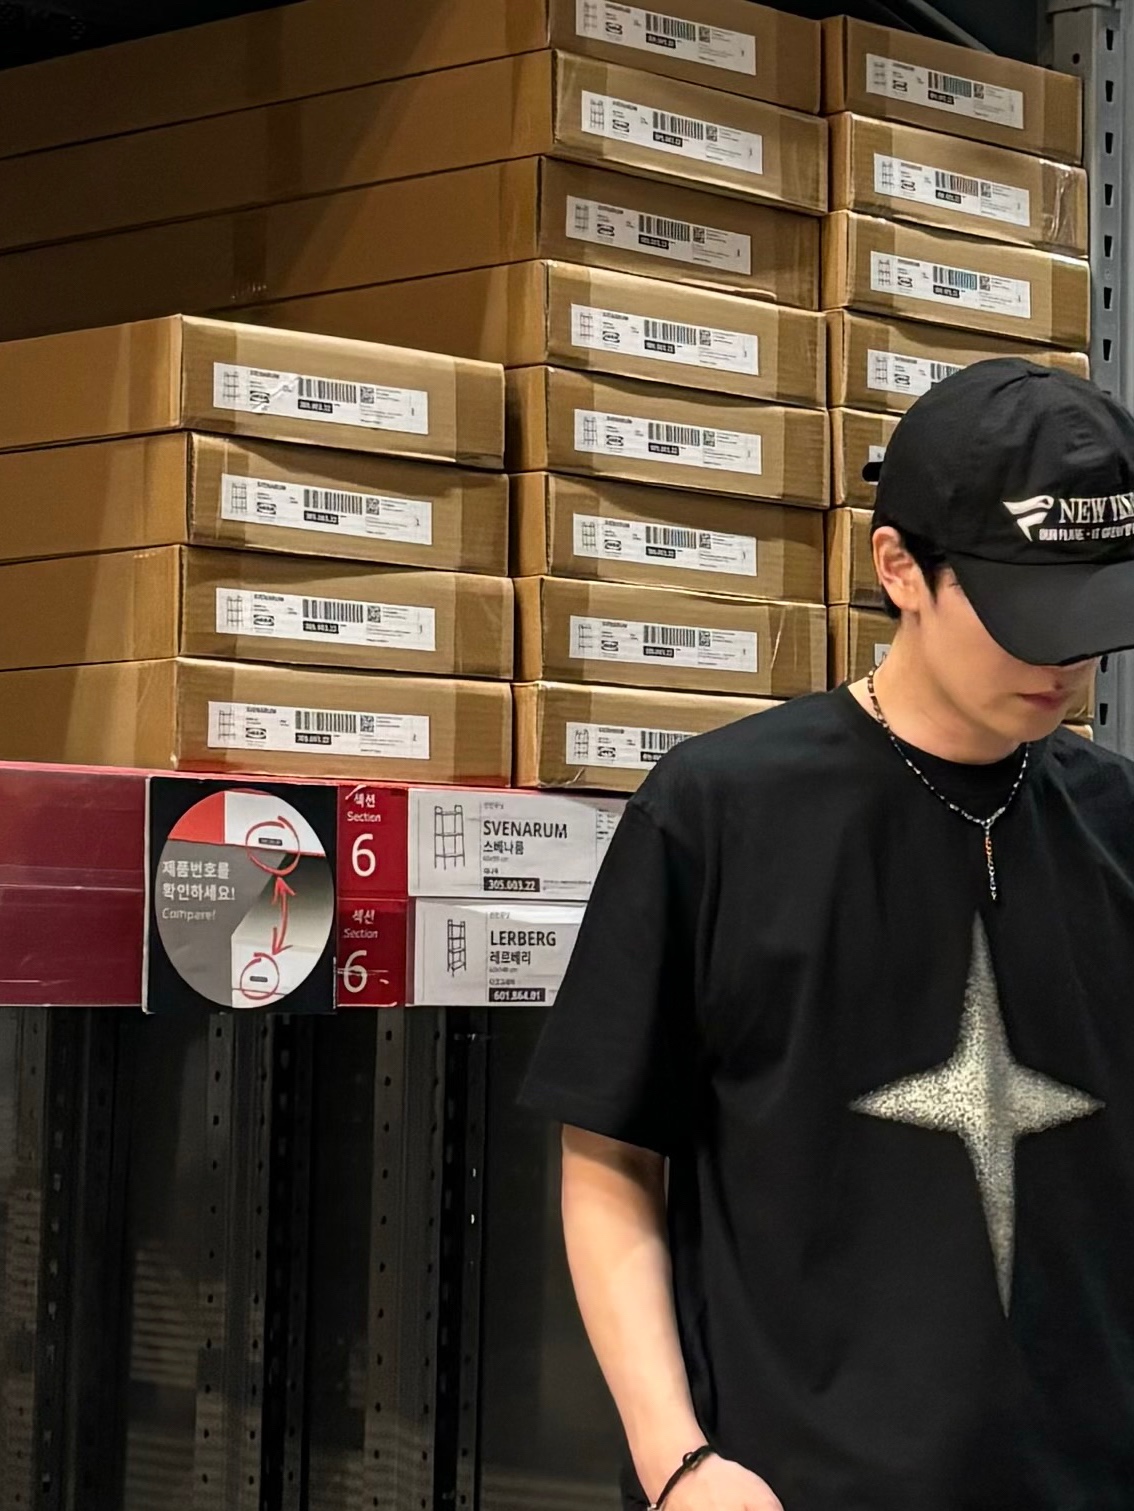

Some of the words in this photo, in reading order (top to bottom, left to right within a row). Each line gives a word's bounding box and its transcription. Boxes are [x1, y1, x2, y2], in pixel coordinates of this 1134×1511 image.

[1059, 497, 1108, 523] NEW
[353, 793, 376, 808] 섹션
[347, 810, 381, 822] Section
[482, 819, 567, 839] SVENARUM
[352, 834, 376, 876] 6
[162, 860, 229, 879] 제품번호를
[163, 883, 235, 901] 확인하세요!
[162, 907, 216, 922] Compare!
[343, 928, 378, 939] Section
[490, 930, 556, 946] LERBERG
[343, 950, 367, 993] 6
